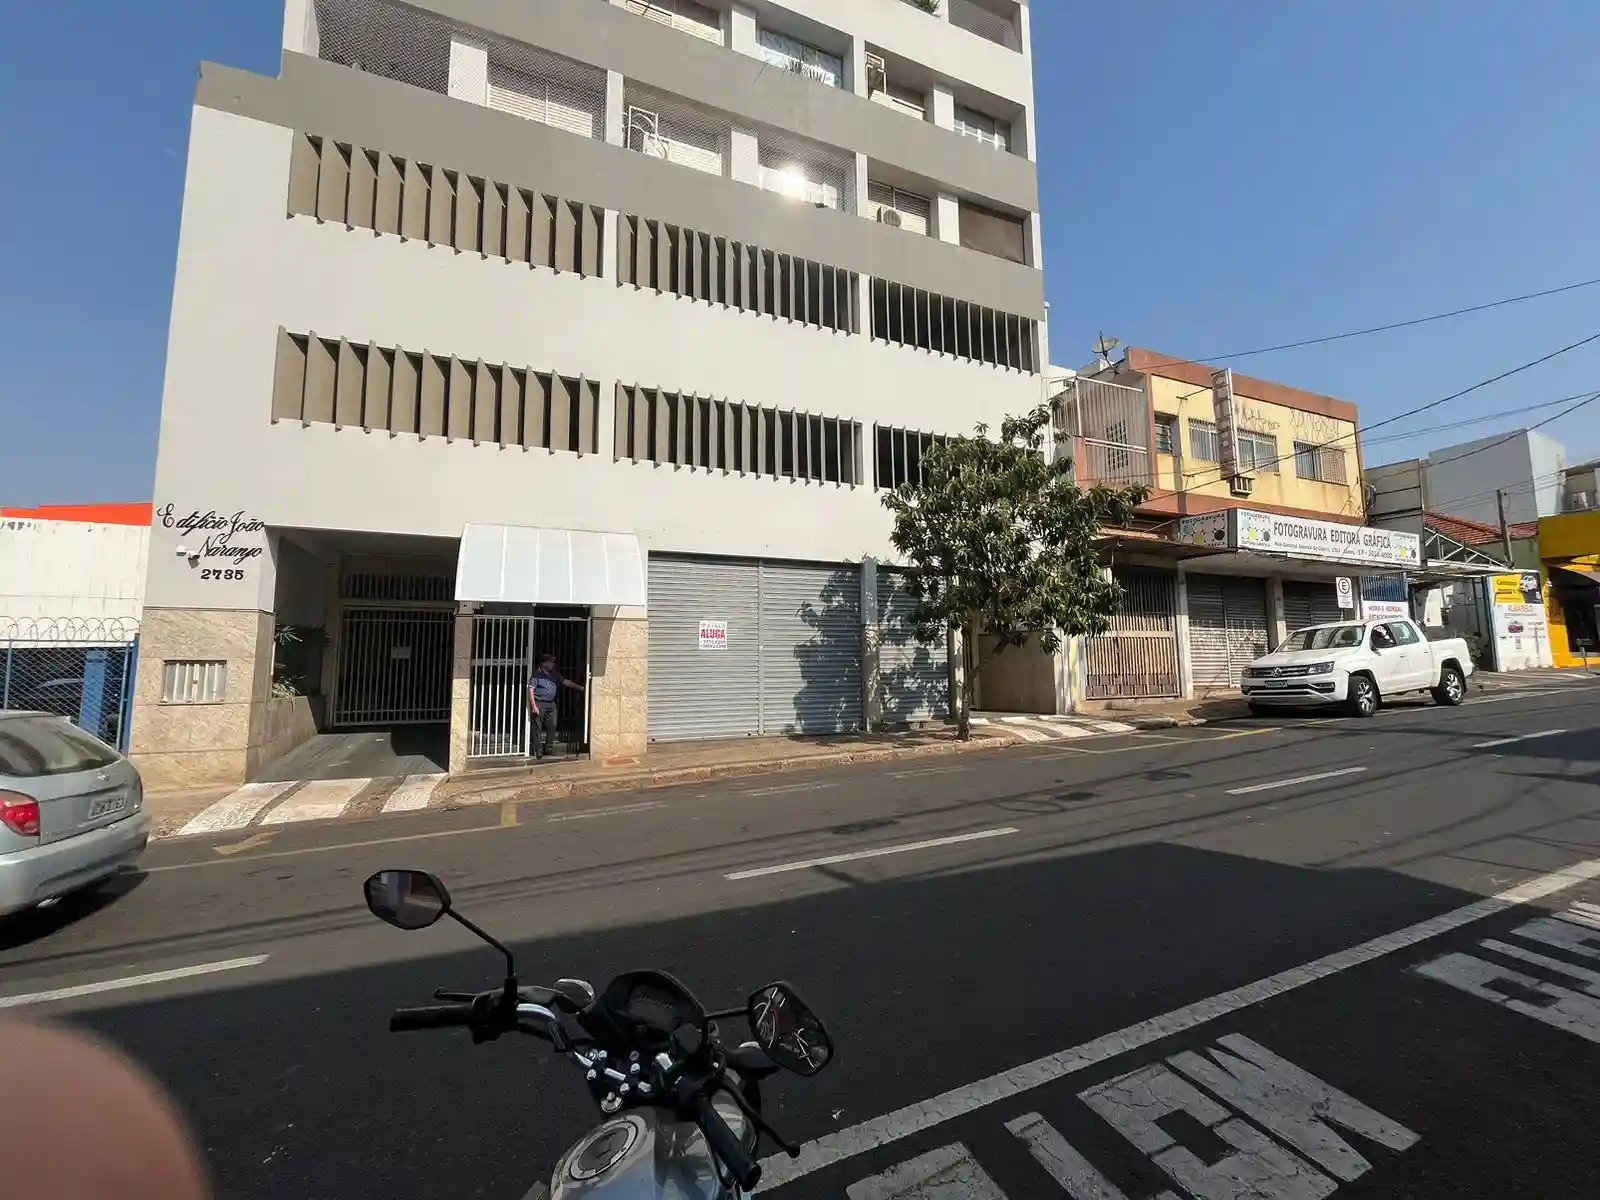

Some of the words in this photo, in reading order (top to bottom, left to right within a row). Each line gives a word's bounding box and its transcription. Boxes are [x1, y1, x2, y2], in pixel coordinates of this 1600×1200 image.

[220, 510, 264, 544] João
[1273, 521, 1328, 541] FOTOGRAVURA
[1330, 529, 1361, 546] EDITORA
[1363, 531, 1391, 549] GRÁFICA
[700, 628, 726, 639] ALUGA
